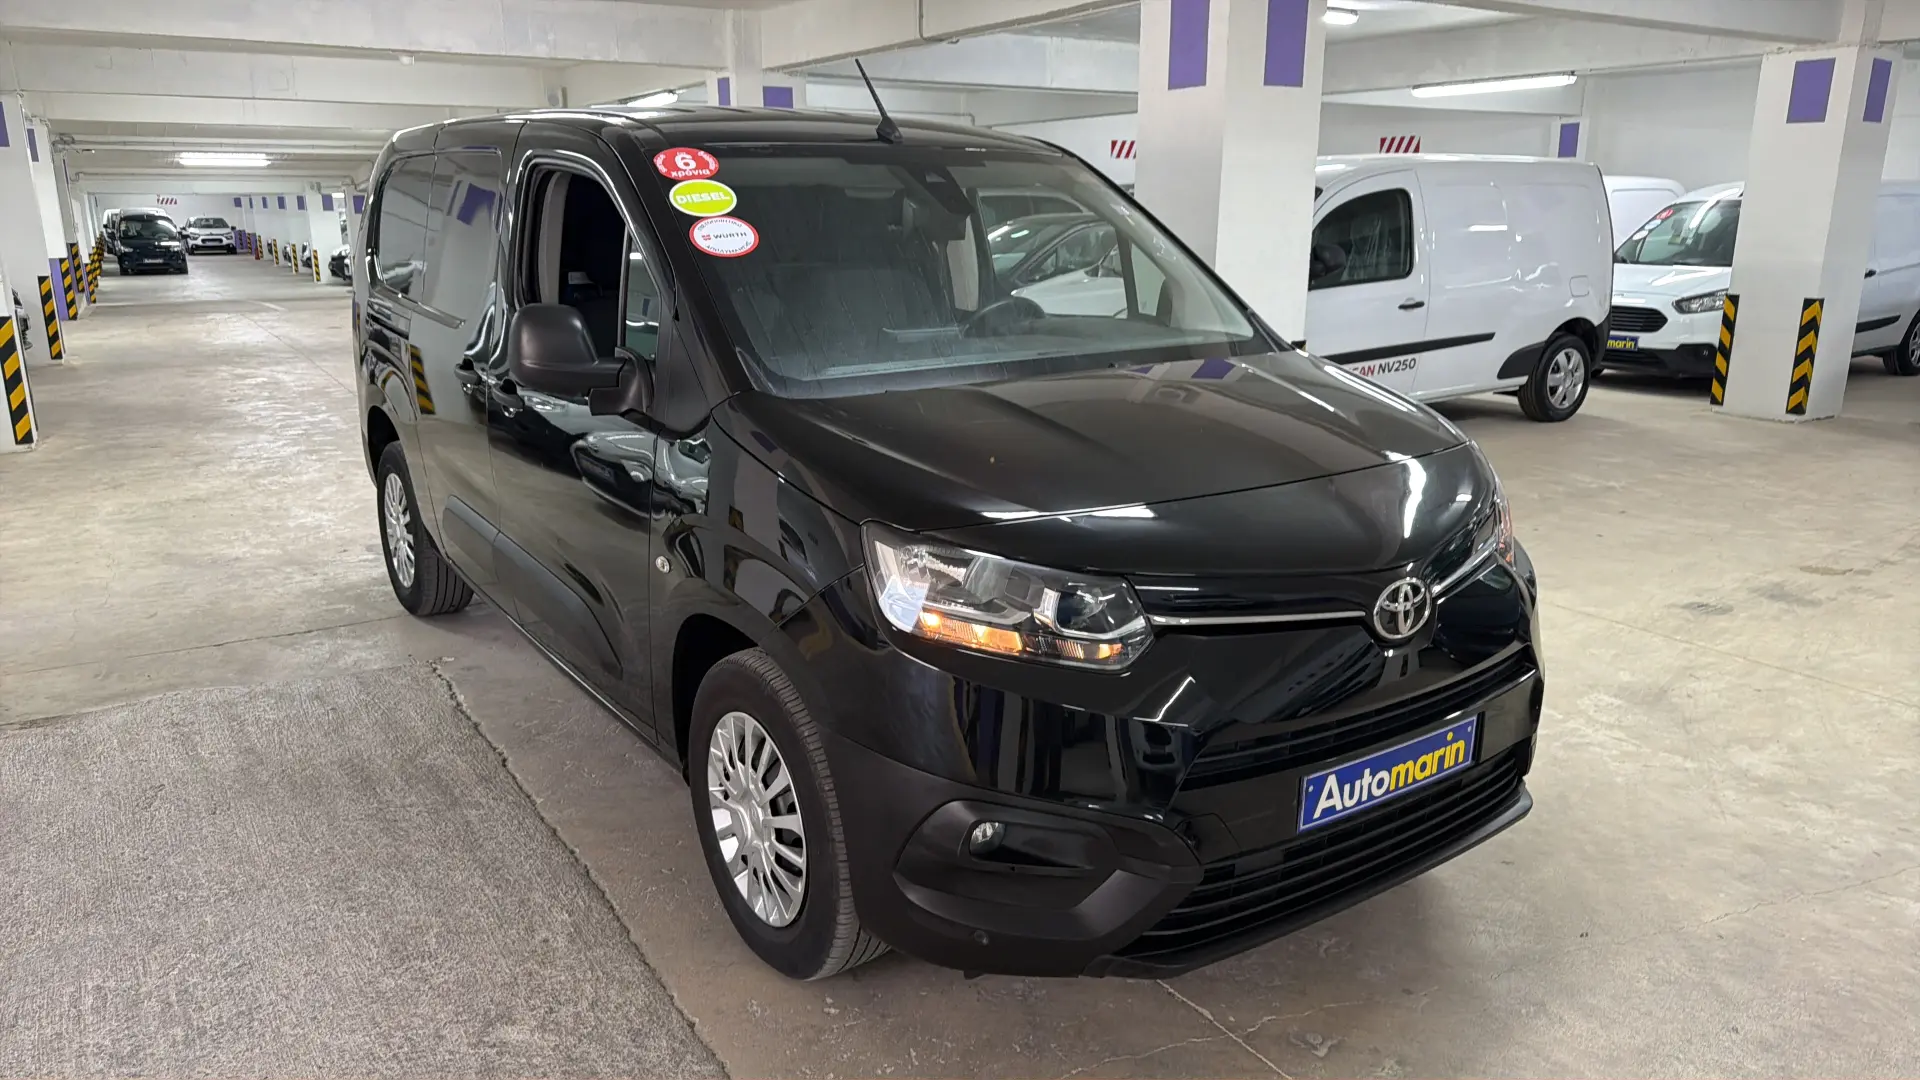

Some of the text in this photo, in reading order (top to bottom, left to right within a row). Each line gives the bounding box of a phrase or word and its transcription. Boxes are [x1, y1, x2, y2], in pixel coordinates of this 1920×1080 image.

[675, 153, 697, 170] 6
[675, 191, 731, 204] DIESEL
[1377, 357, 1417, 375] NV250
[1313, 731, 1465, 820] Automarin
